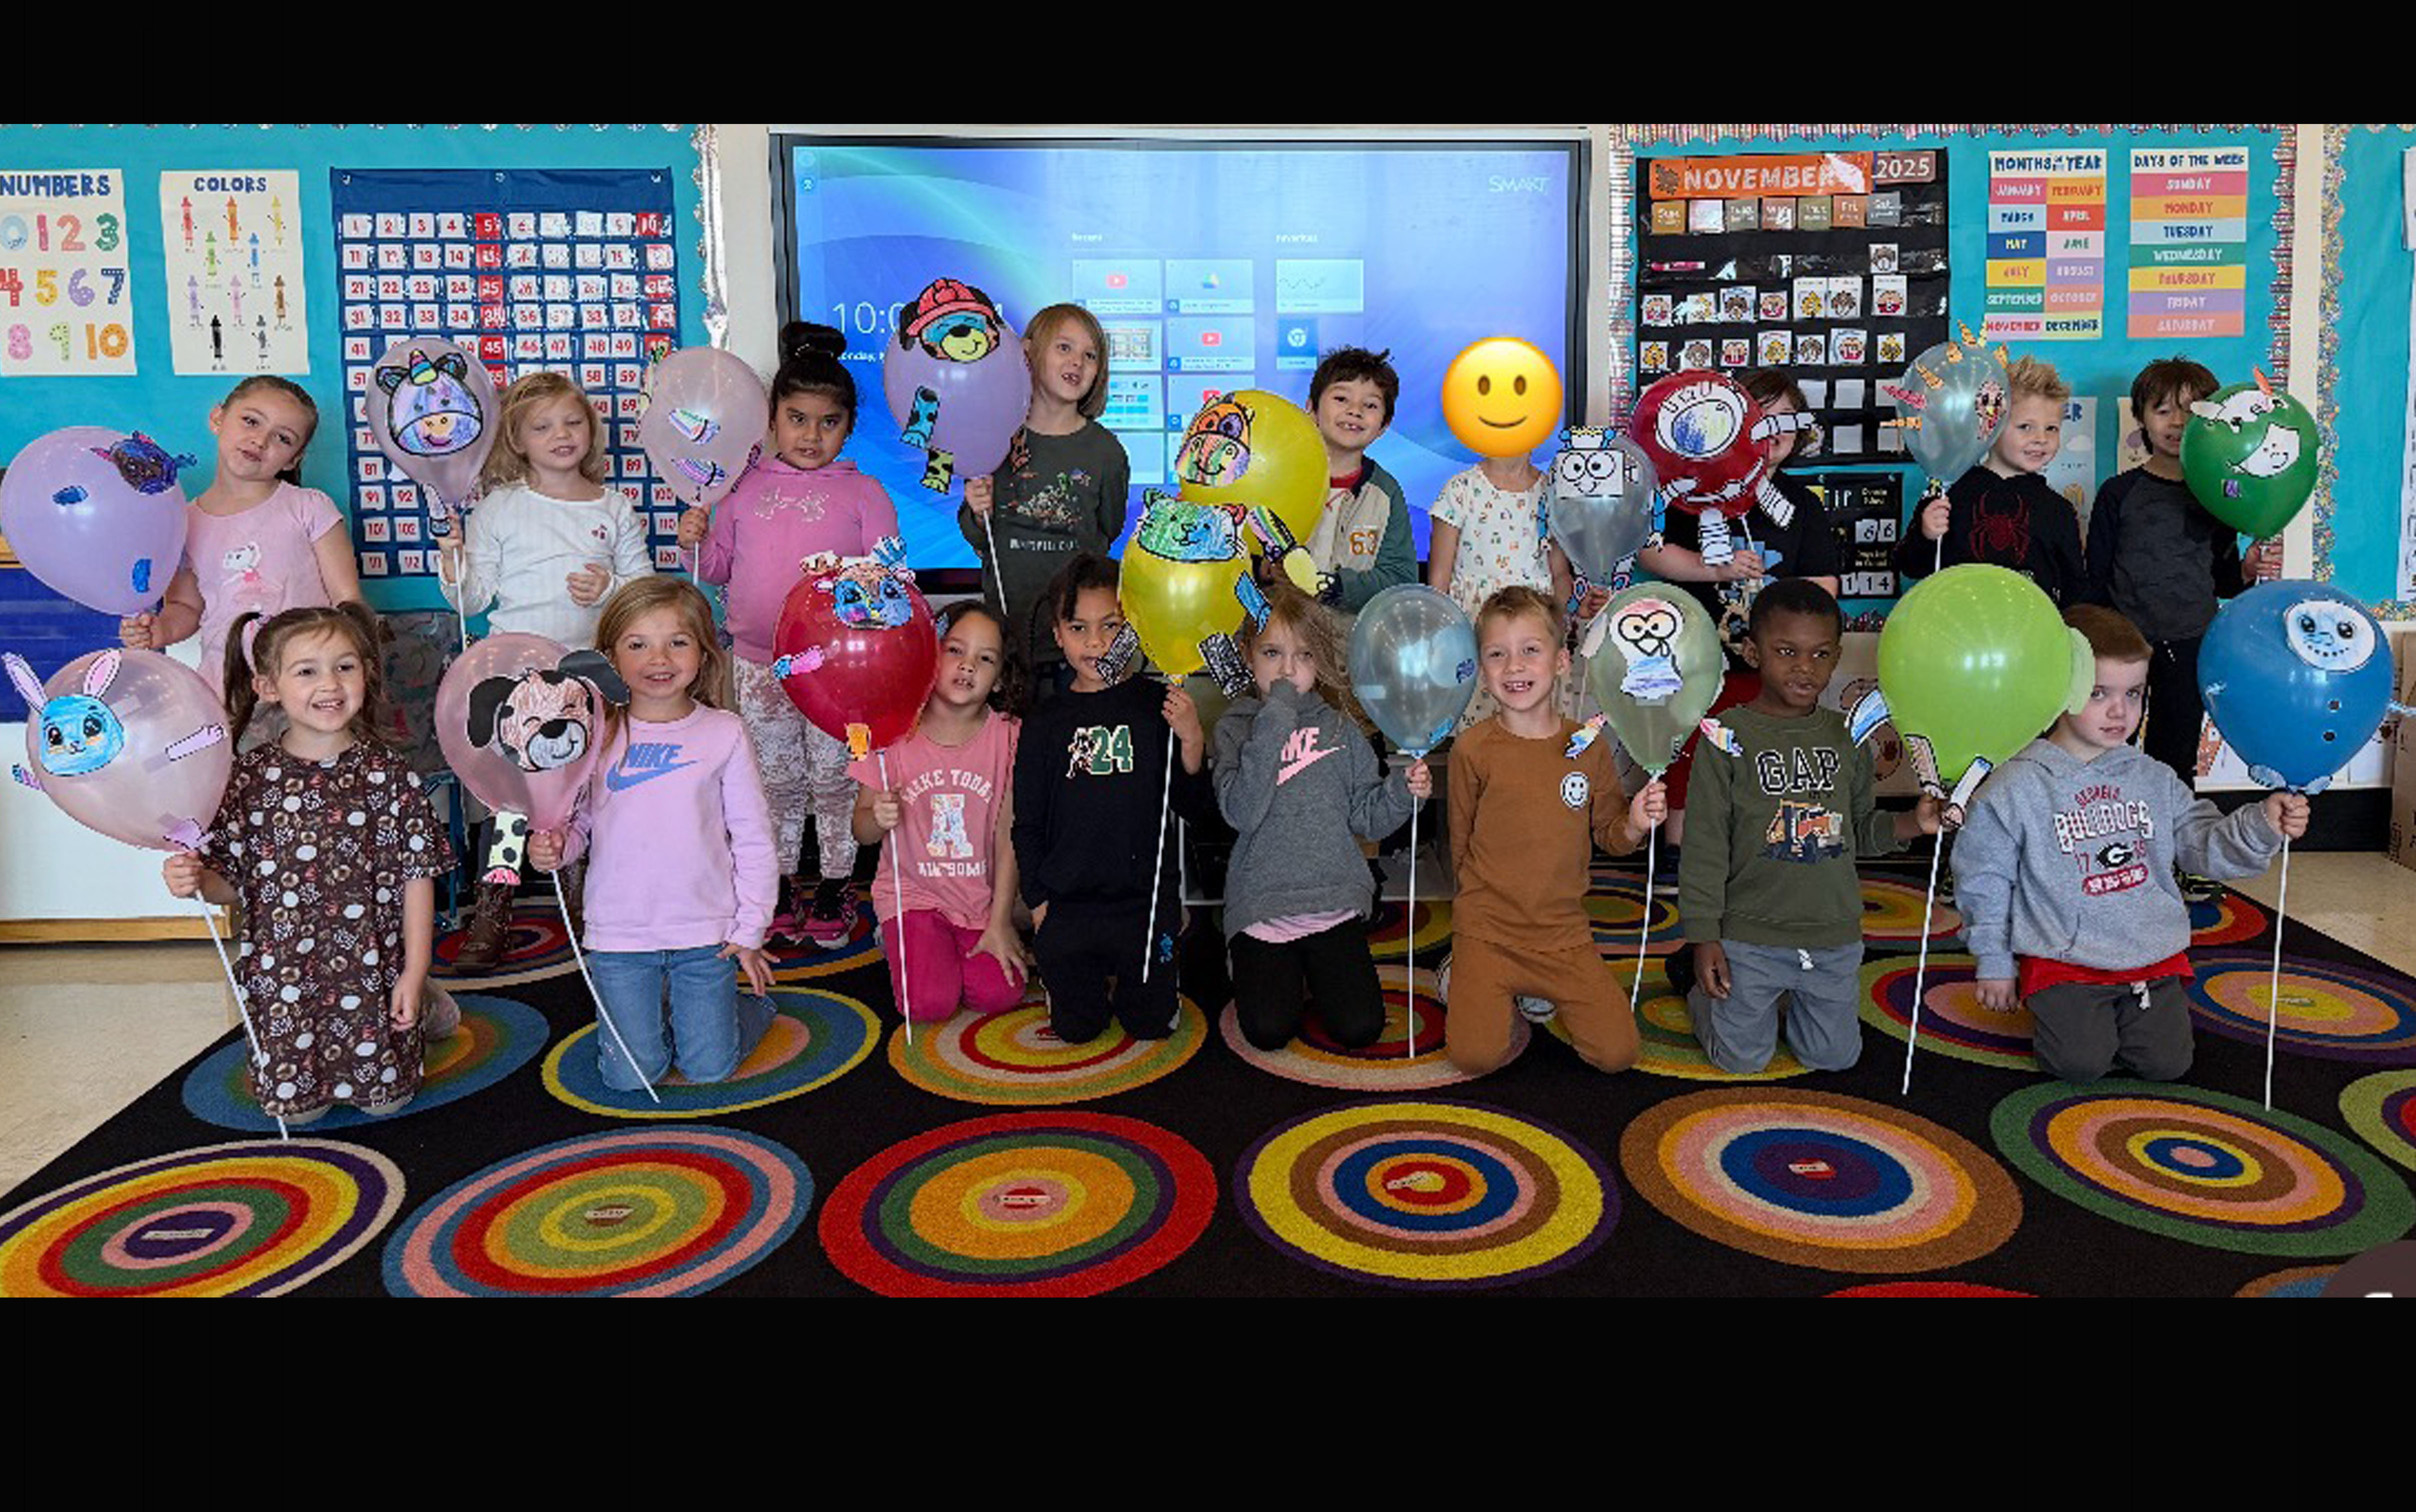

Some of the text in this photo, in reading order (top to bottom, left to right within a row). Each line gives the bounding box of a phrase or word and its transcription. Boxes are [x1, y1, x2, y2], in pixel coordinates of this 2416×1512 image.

[1994, 158, 2051, 171] MONTHS
[2066, 155, 2102, 170] YEAR
[2134, 154, 2244, 167] DAYS OF THE WEEK
[1876, 158, 1930, 178] 2025
[1684, 164, 1834, 190] NOVEMBER
[0, 174, 110, 197] NUMBERS
[194, 176, 266, 192] COLORS
[1488, 176, 1552, 194] SMART
[2166, 178, 2211, 190] SUNDAY
[2164, 202, 2213, 214] MONDAY
[384, 219, 393, 233] 2
[418, 219, 426, 232] 3
[446, 219, 456, 232] 4
[484, 218, 493, 232] 5
[2164, 226, 2213, 238] TUESDAY
[1, 213, 120, 252] 0 1 2 3
[2006, 239, 2028, 250] MAY
[2064, 238, 2089, 249] JUNE
[350, 250, 362, 262] 11
[419, 250, 433, 262] 13
[450, 250, 464, 263] 14
[2153, 248, 2222, 261] WEDNESDAY
[2004, 266, 2029, 278] JULY
[2159, 273, 2216, 284] THURSDAY
[0, 268, 124, 307] 4 5 6 7
[351, 282, 364, 294] 21
[382, 282, 399, 294] 22
[414, 282, 430, 294] 23
[451, 282, 468, 294] 24
[1986, 294, 2042, 304] SEPTEMBER
[2168, 297, 2206, 309] FRIDAY
[351, 310, 366, 325] 31
[384, 310, 402, 323] 32
[420, 310, 435, 323] 33
[451, 310, 468, 322] 34
[832, 302, 901, 334] 10:0
[1986, 321, 2042, 332] NOVEMBER
[2046, 319, 2099, 332] DECEMBER
[2157, 319, 2216, 331] SATURDAY
[8, 322, 128, 361] 8 9 10
[484, 342, 502, 354] 45
[616, 340, 632, 352] 49
[586, 371, 601, 383] 58
[620, 370, 636, 383] 59
[622, 399, 638, 412] 69
[626, 458, 642, 471] 89
[365, 490, 380, 503] 91
[398, 490, 413, 502] 92
[627, 742, 683, 768] NIKE
[1088, 725, 1133, 774] 24
[1756, 747, 1840, 796] GAP
[902, 769, 945, 806] MAKE
[926, 794, 974, 860] A
[2054, 800, 2153, 853] BULLDOGS
